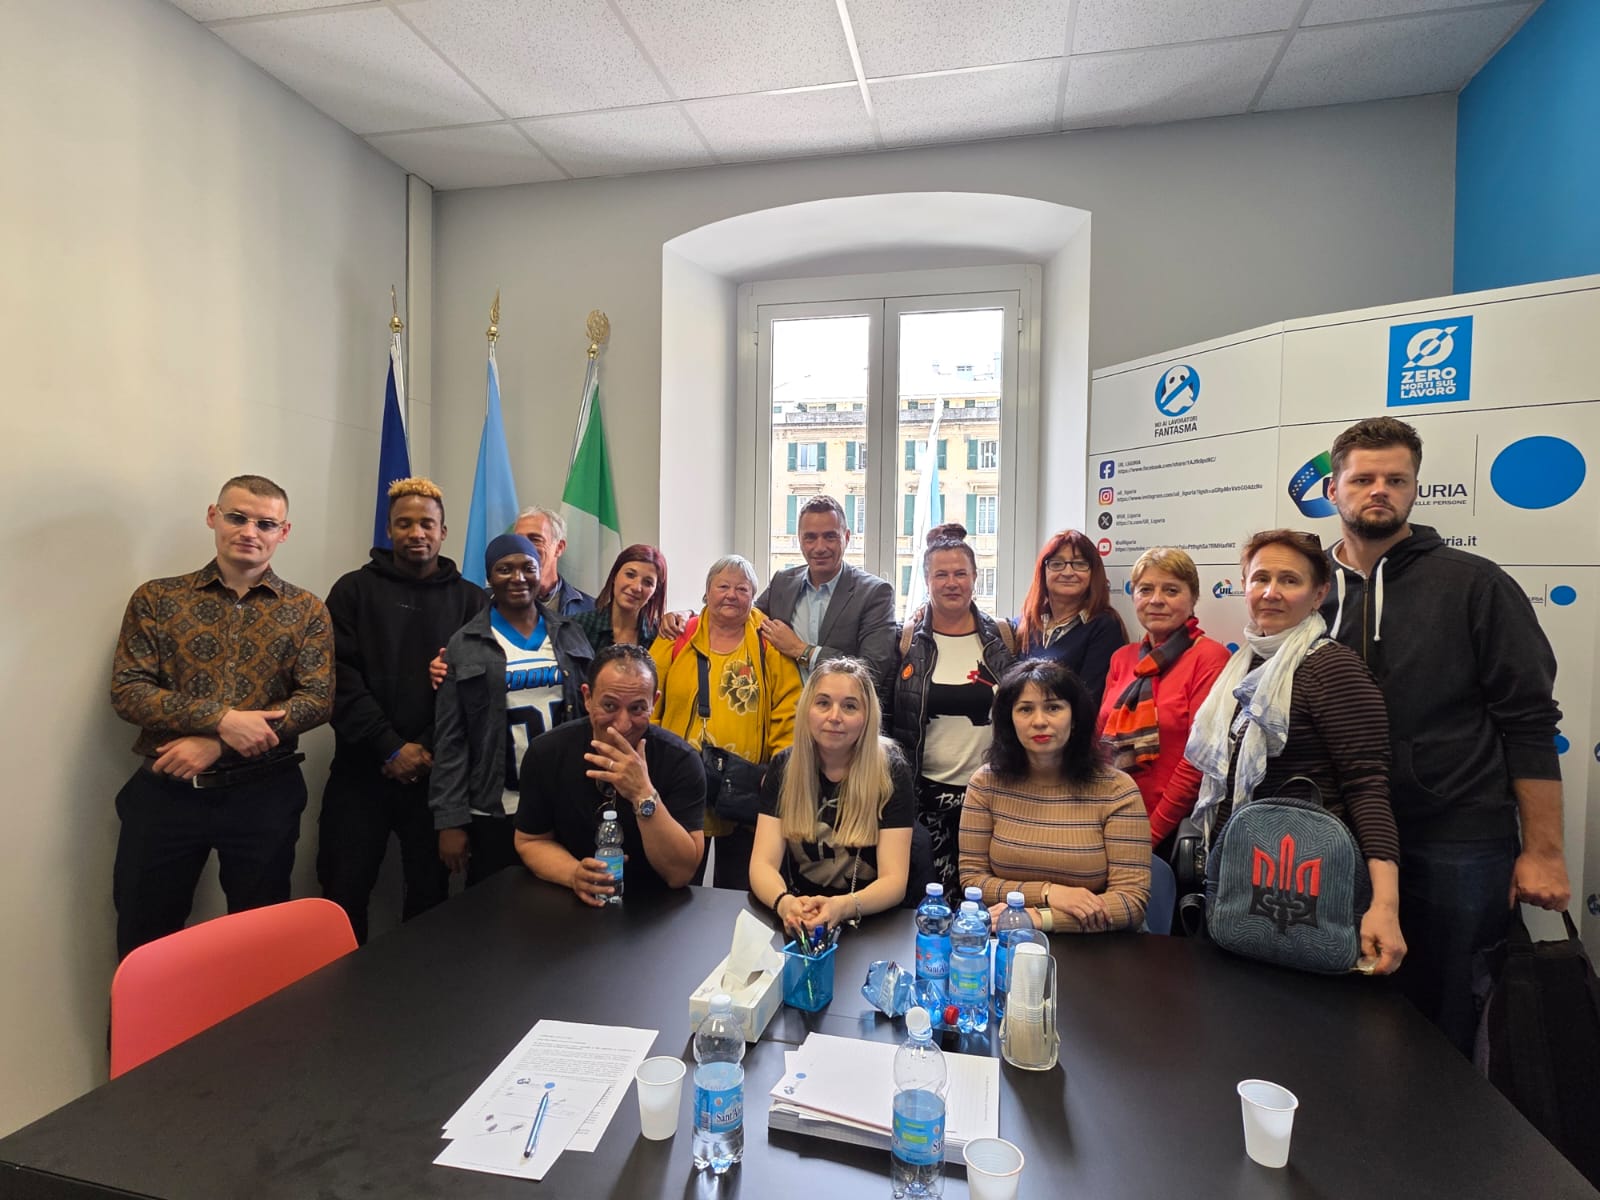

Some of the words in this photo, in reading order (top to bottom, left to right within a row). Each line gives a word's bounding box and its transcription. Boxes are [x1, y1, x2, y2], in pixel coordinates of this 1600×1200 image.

[1401, 367, 1457, 384] ZERO
[1400, 386, 1456, 399] LAVORO
[1401, 381, 1434, 390] MORTI
[1155, 422, 1198, 438] FANTASMA
[1418, 484, 1468, 498] URIA
